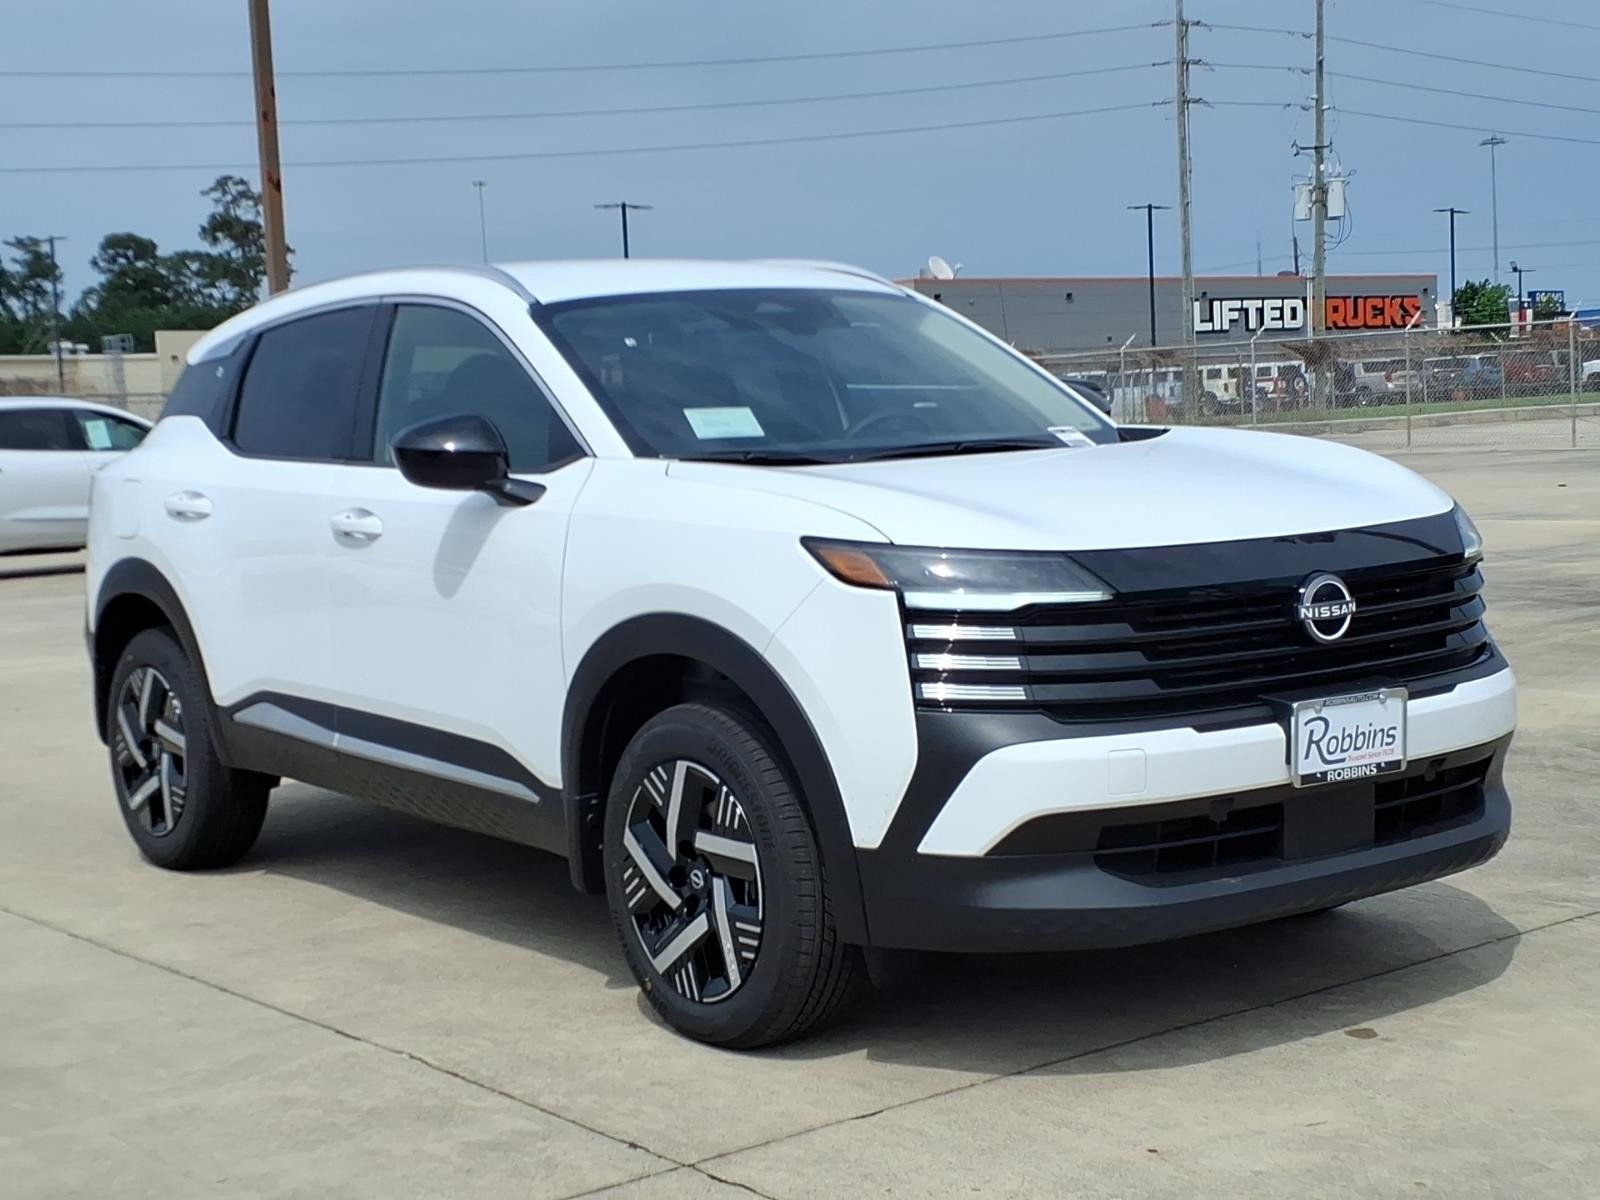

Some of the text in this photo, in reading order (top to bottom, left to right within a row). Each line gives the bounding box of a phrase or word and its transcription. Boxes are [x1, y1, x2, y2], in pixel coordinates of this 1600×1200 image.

[1194, 296, 1422, 332] LIFTED RUCKS
[1301, 600, 1356, 618] NISSAN
[1304, 716, 1397, 765] Robbins
[1327, 765, 1377, 781] ROBBINS
